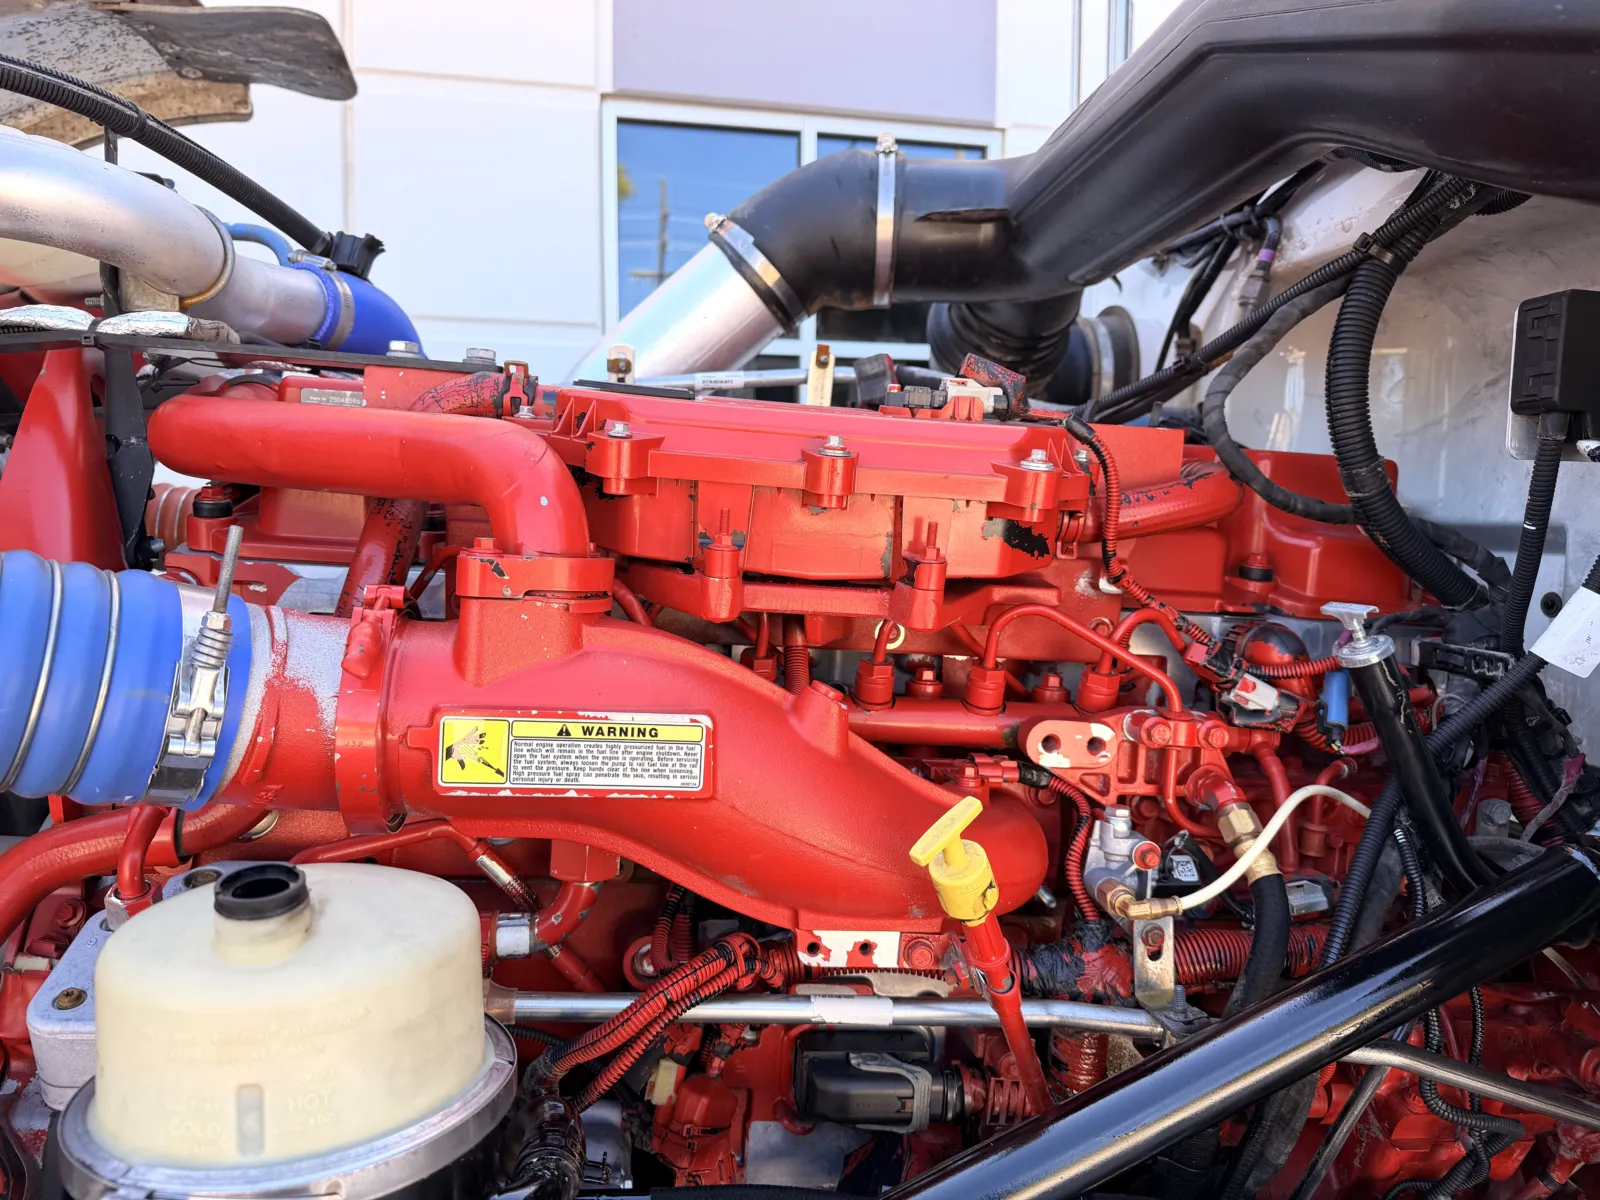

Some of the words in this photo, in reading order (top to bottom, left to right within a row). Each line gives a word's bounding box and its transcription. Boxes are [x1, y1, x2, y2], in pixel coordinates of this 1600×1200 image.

[581, 726, 659, 738] WARNING
[288, 1091, 331, 1112] HOT
[168, 1117, 221, 1139] COLD
